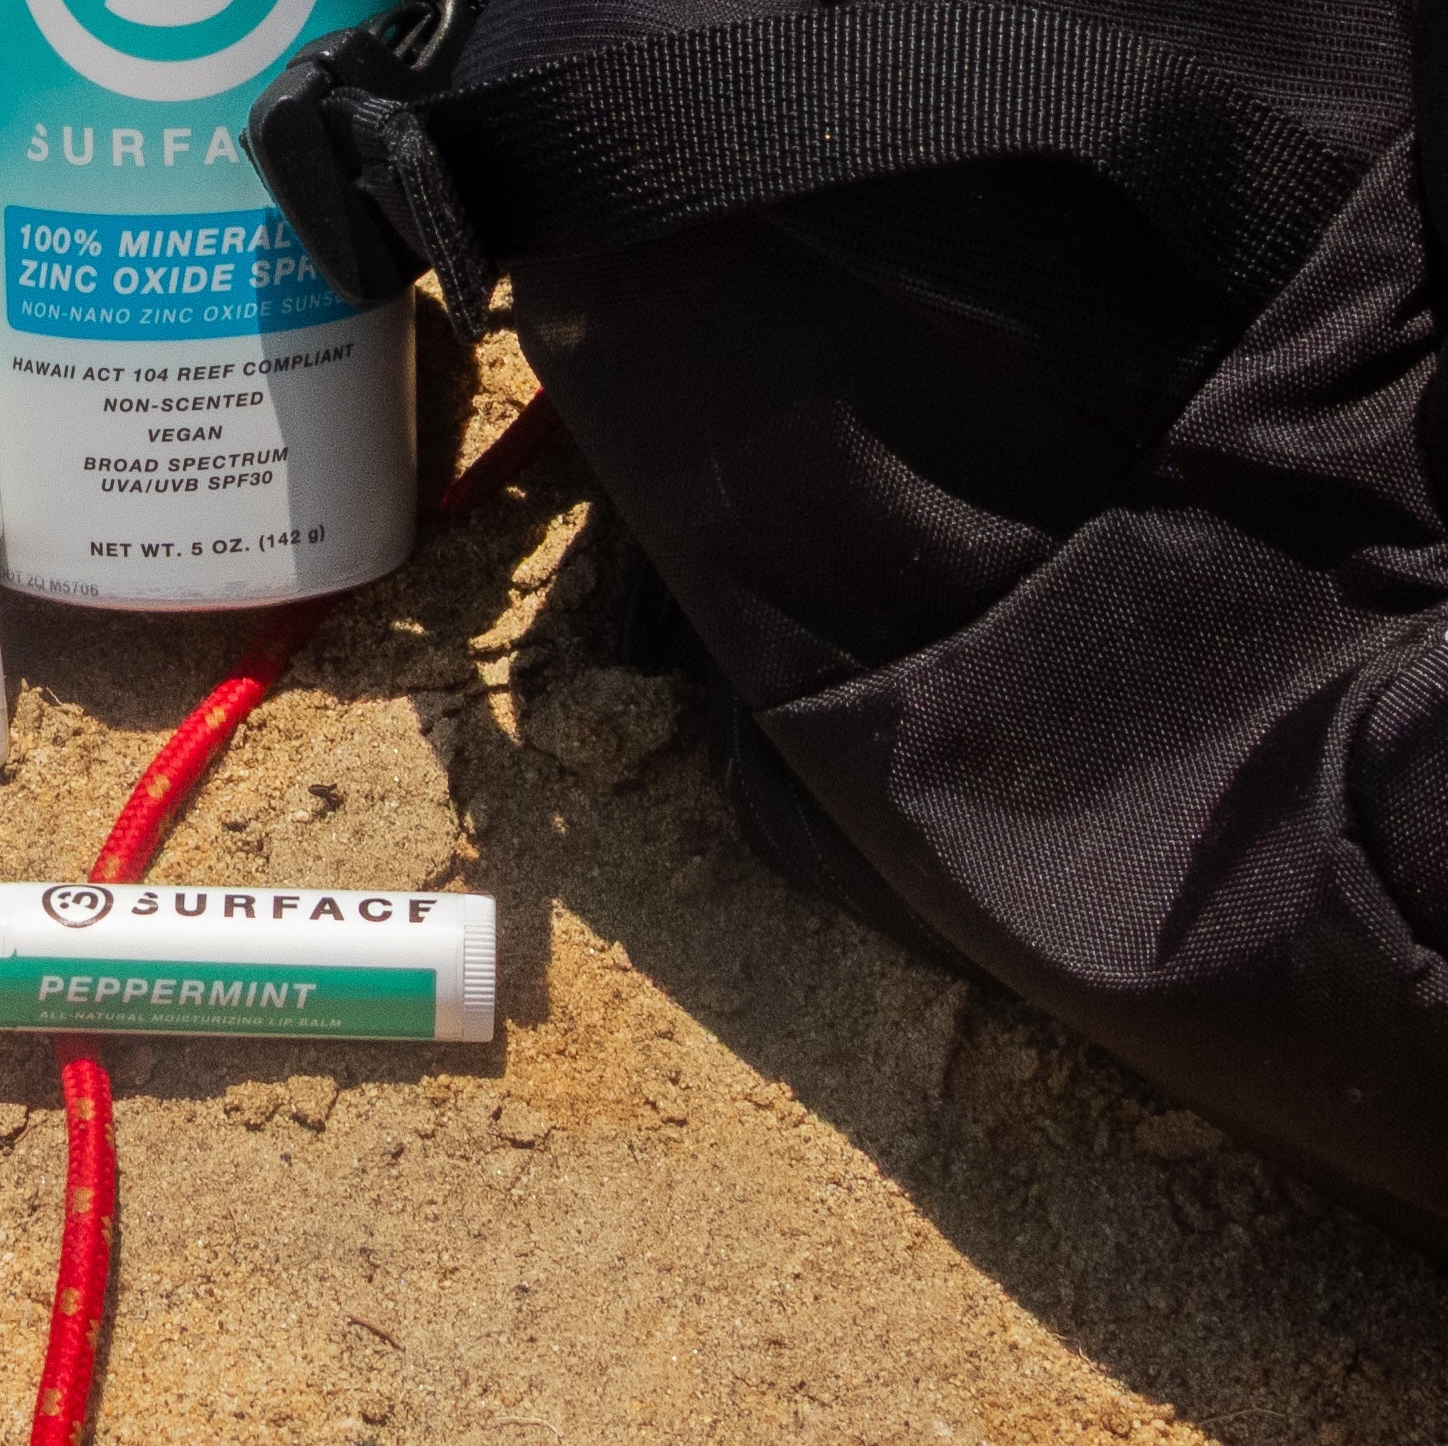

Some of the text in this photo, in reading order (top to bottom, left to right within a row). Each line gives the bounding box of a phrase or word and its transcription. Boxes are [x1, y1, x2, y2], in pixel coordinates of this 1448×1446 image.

[26, 123, 239, 167] SURFA
[20, 221, 291, 257] 100% MINERAL
[18, 255, 318, 295] ZINC OXIDE SPR
[21, 300, 131, 324] NON-NANO
[139, 307, 193, 324] ZINC
[203, 301, 272, 323] OXIDE
[12, 344, 355, 383] HAWAII ACT 104 REEF COMPLIANT
[103, 391, 265, 413] NON-SCENTED
[148, 425, 223, 443] VEGAN
[83, 447, 289, 473] BROAD SPECTRUM
[101, 471, 273, 494] UVA/UVB SPF30
[90, 524, 326, 558] NET WT. 5 OZ. (142 g)
[132, 891, 437, 923] SURFACE
[38, 975, 318, 1009] PEPPERMINT
[152, 1014, 263, 1026] MOISTURIZING
[300, 1017, 343, 1028] BALM
